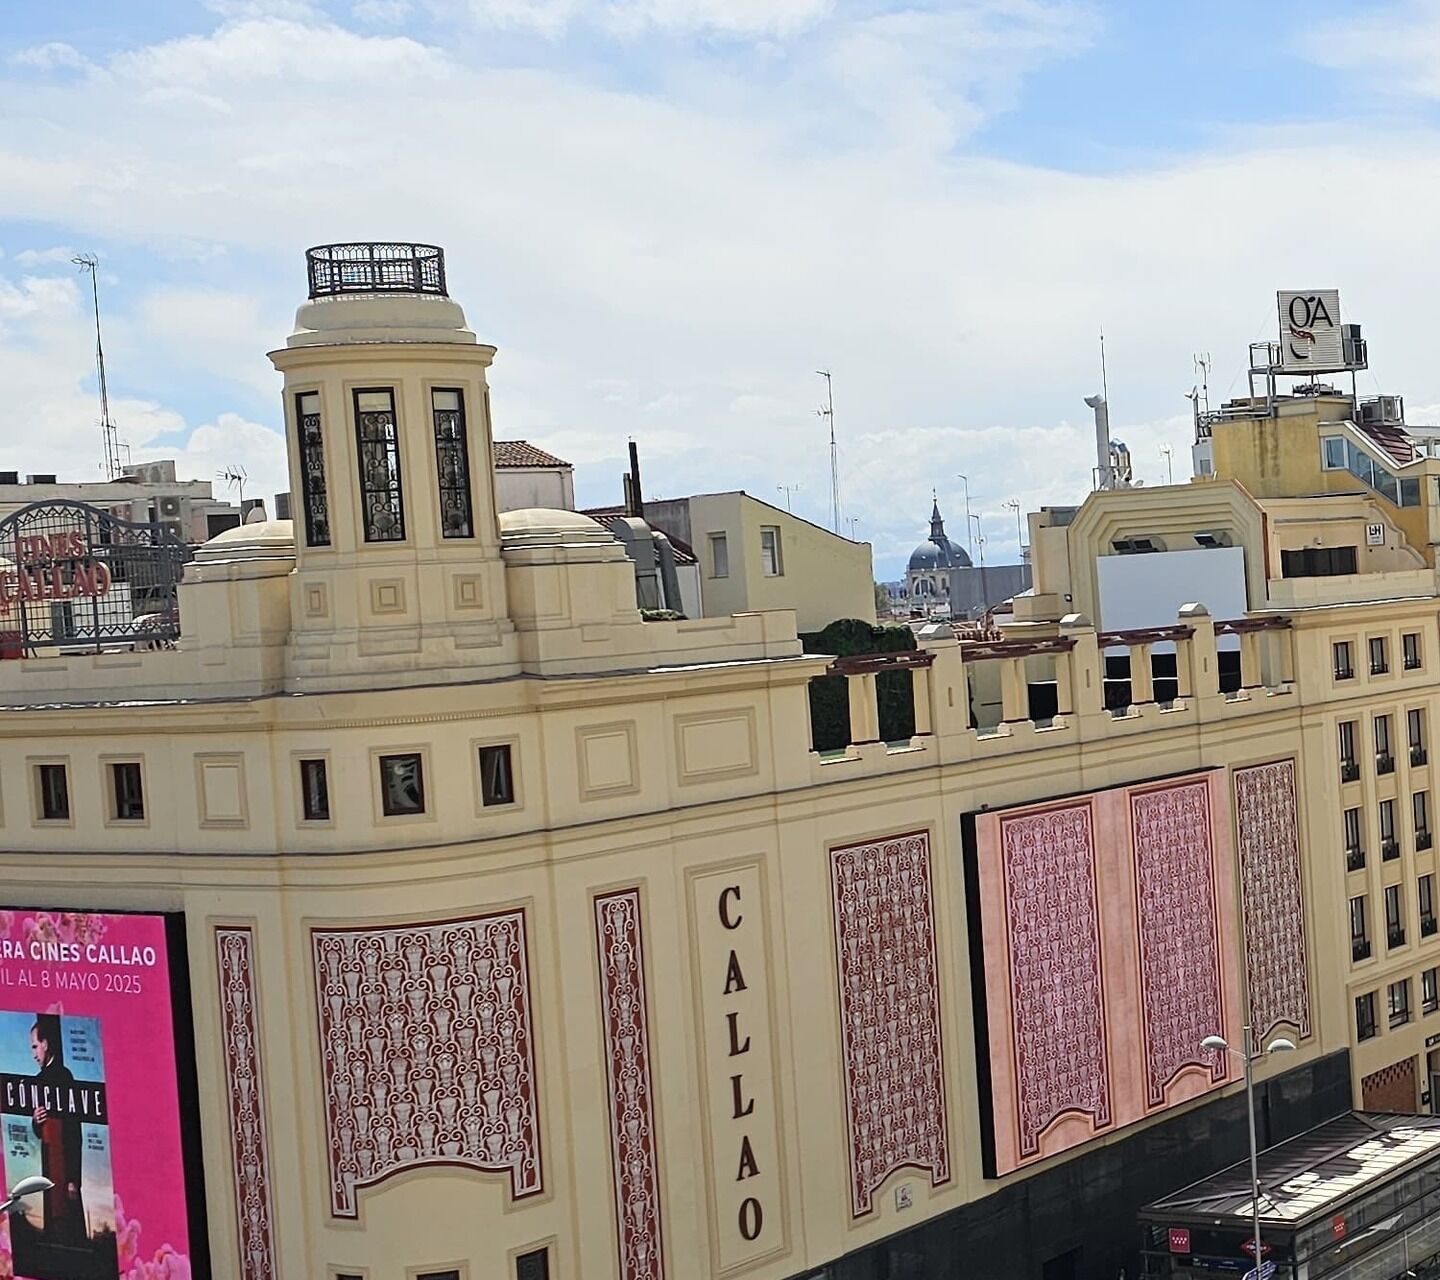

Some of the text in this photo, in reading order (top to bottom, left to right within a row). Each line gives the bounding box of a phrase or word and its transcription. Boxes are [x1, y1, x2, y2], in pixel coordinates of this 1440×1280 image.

[0, 561, 112, 603] CALLAO
[0, 940, 156, 967] RA CINES CALLAO
[18, 969, 37, 987] AL
[41, 970, 51, 988] 8
[56, 972, 100, 992] MAYO
[104, 973, 142, 994] 2025
[718, 885, 763, 1241] CALLAO
[6, 1079, 102, 1116] CÓNCLAVE
